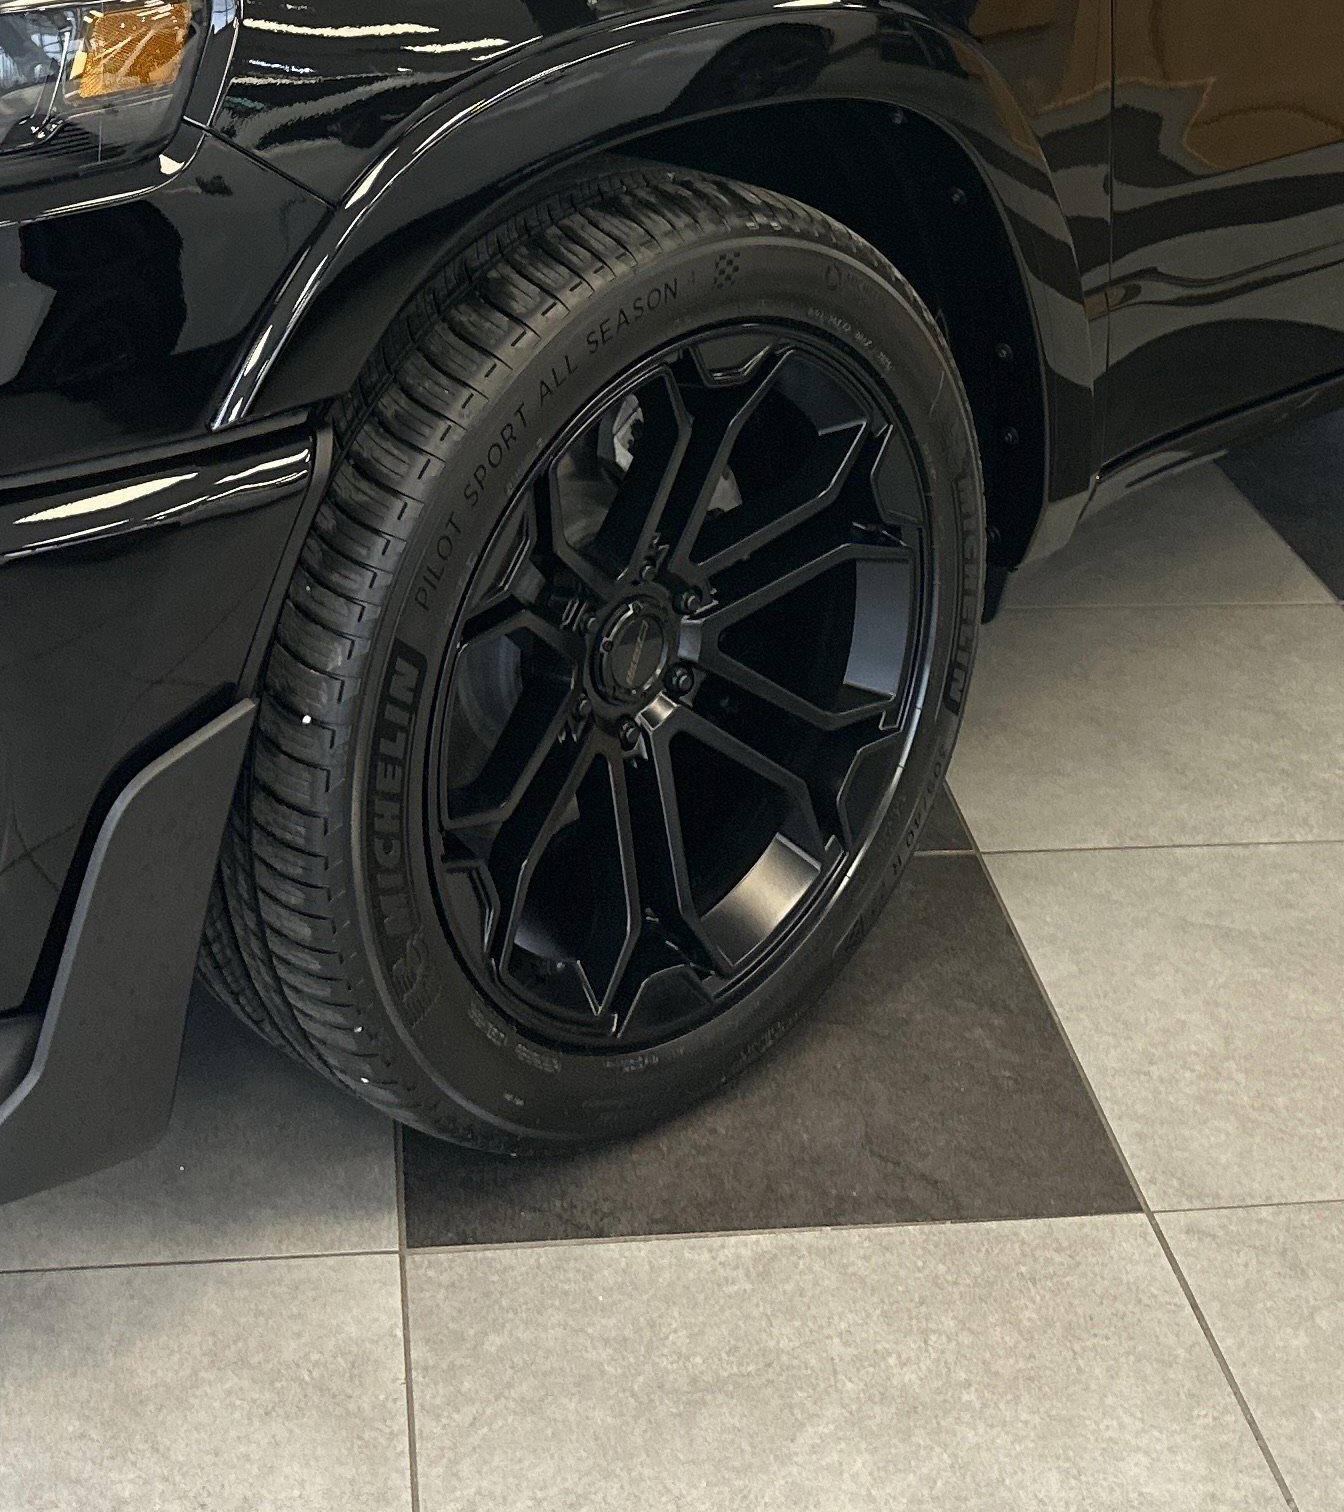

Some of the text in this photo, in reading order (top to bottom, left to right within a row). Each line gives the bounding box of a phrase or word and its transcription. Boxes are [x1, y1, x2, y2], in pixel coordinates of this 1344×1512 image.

[414, 512, 464, 613] PILOT
[463, 403, 528, 507] SPORT
[539, 355, 579, 405] ALL
[586, 277, 679, 355] SEASON
[372, 656, 420, 937] MICHELIN
